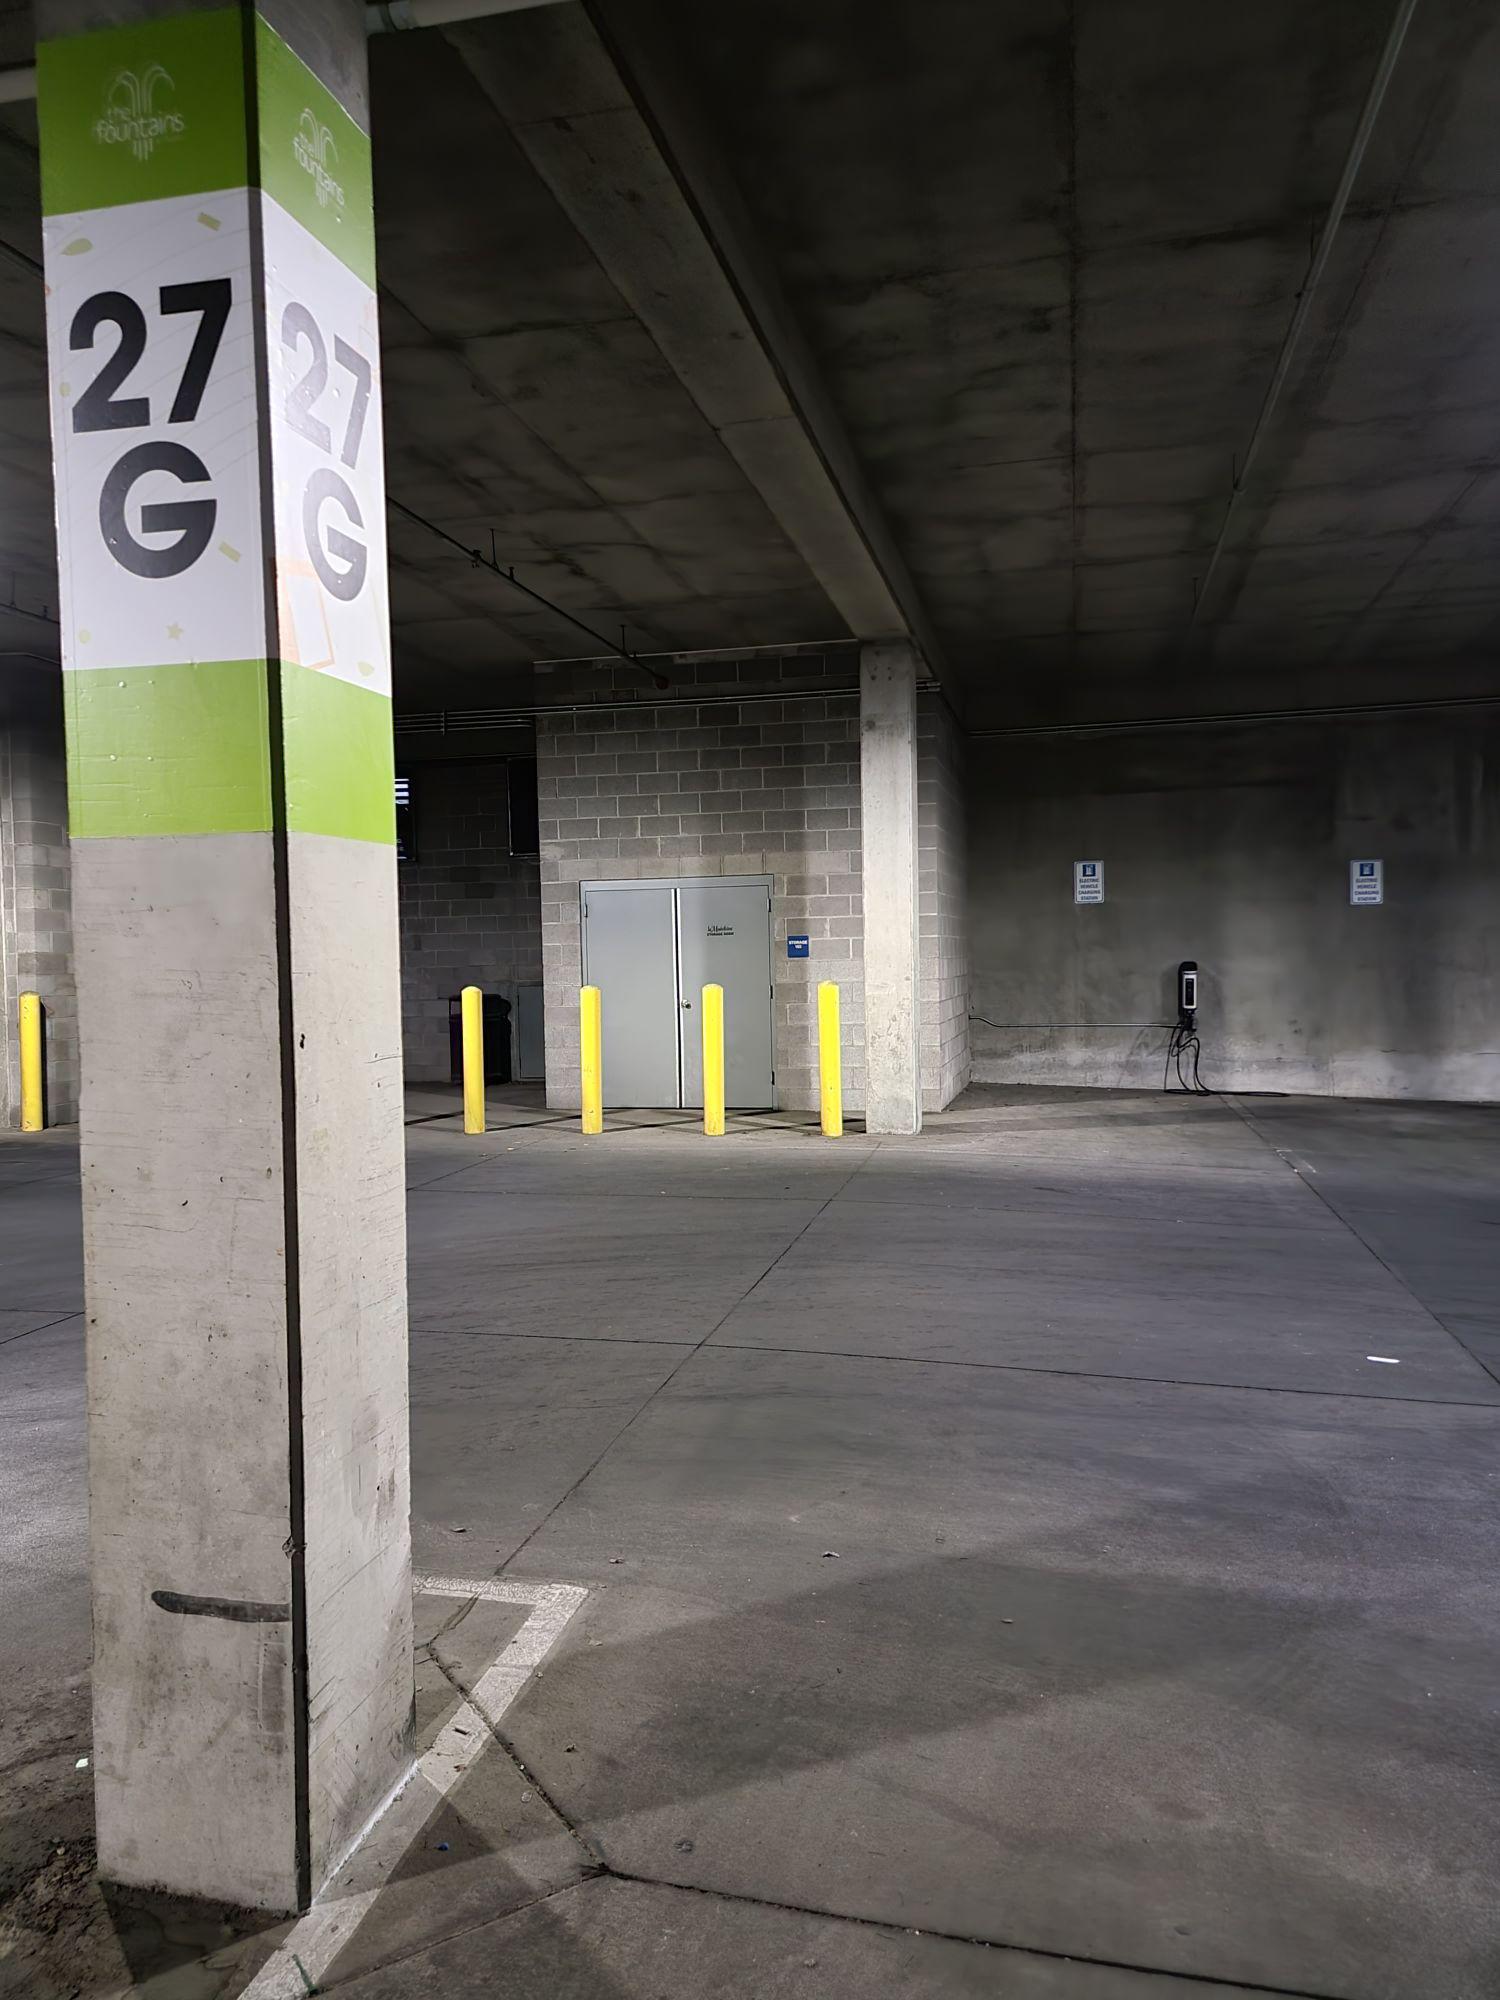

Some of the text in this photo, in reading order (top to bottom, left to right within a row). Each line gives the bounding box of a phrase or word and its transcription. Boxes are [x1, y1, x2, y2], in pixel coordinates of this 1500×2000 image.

[69, 277, 233, 434] 27
[280, 300, 372, 471] 27
[99, 440, 217, 579] G
[302, 468, 367, 602] G
